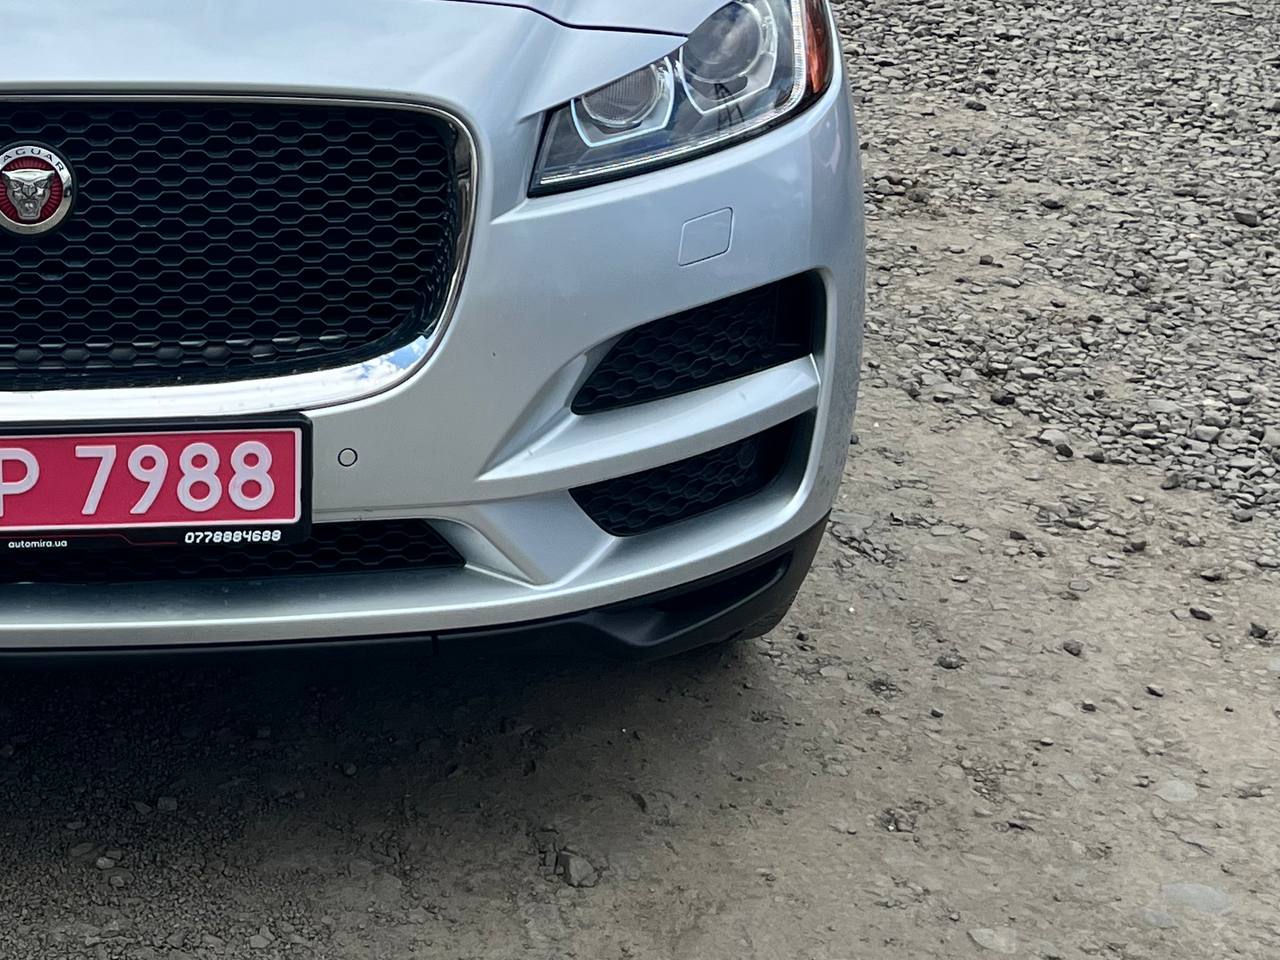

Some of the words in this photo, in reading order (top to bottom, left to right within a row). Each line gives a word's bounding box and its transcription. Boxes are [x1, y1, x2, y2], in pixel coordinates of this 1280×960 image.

[74, 440, 275, 516] 7988
[8, 539, 68, 549] automira.ua
[184, 530, 282, 544] 0778884688
